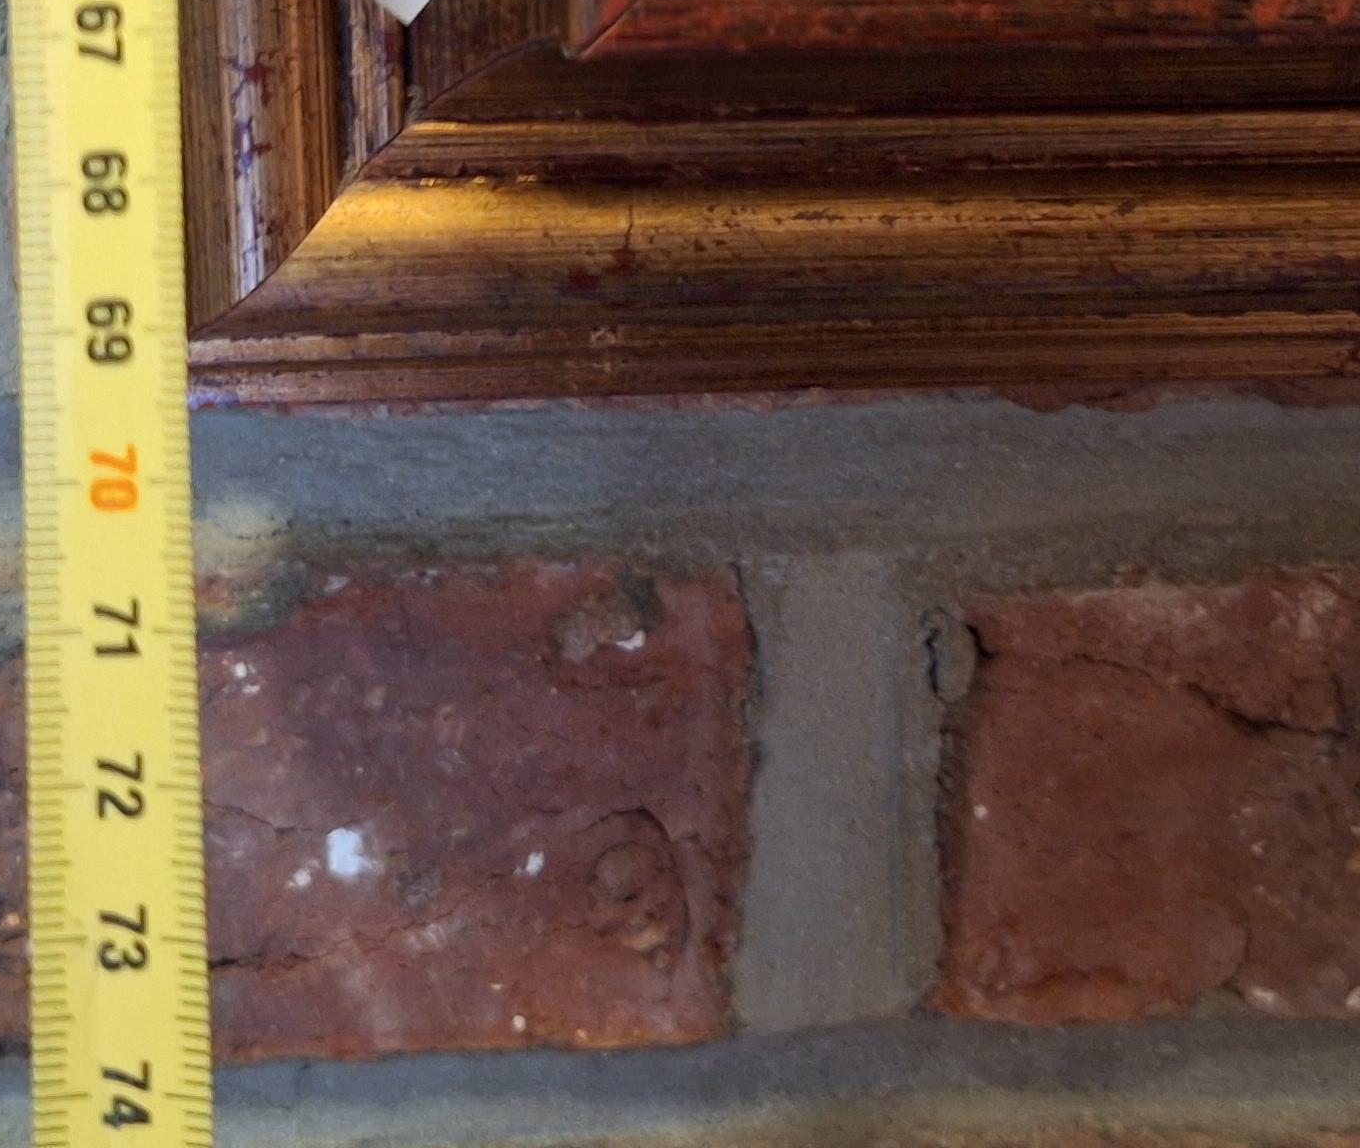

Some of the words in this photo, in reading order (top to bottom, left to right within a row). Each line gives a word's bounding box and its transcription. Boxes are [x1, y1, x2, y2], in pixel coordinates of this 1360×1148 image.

[74, 2, 125, 66] 67
[80, 151, 129, 216] 68
[84, 298, 134, 365] 69
[88, 444, 140, 513] 70
[92, 597, 142, 659] 71
[96, 752, 146, 820] 72
[96, 904, 149, 973] 73
[101, 1061, 153, 1130] 74
